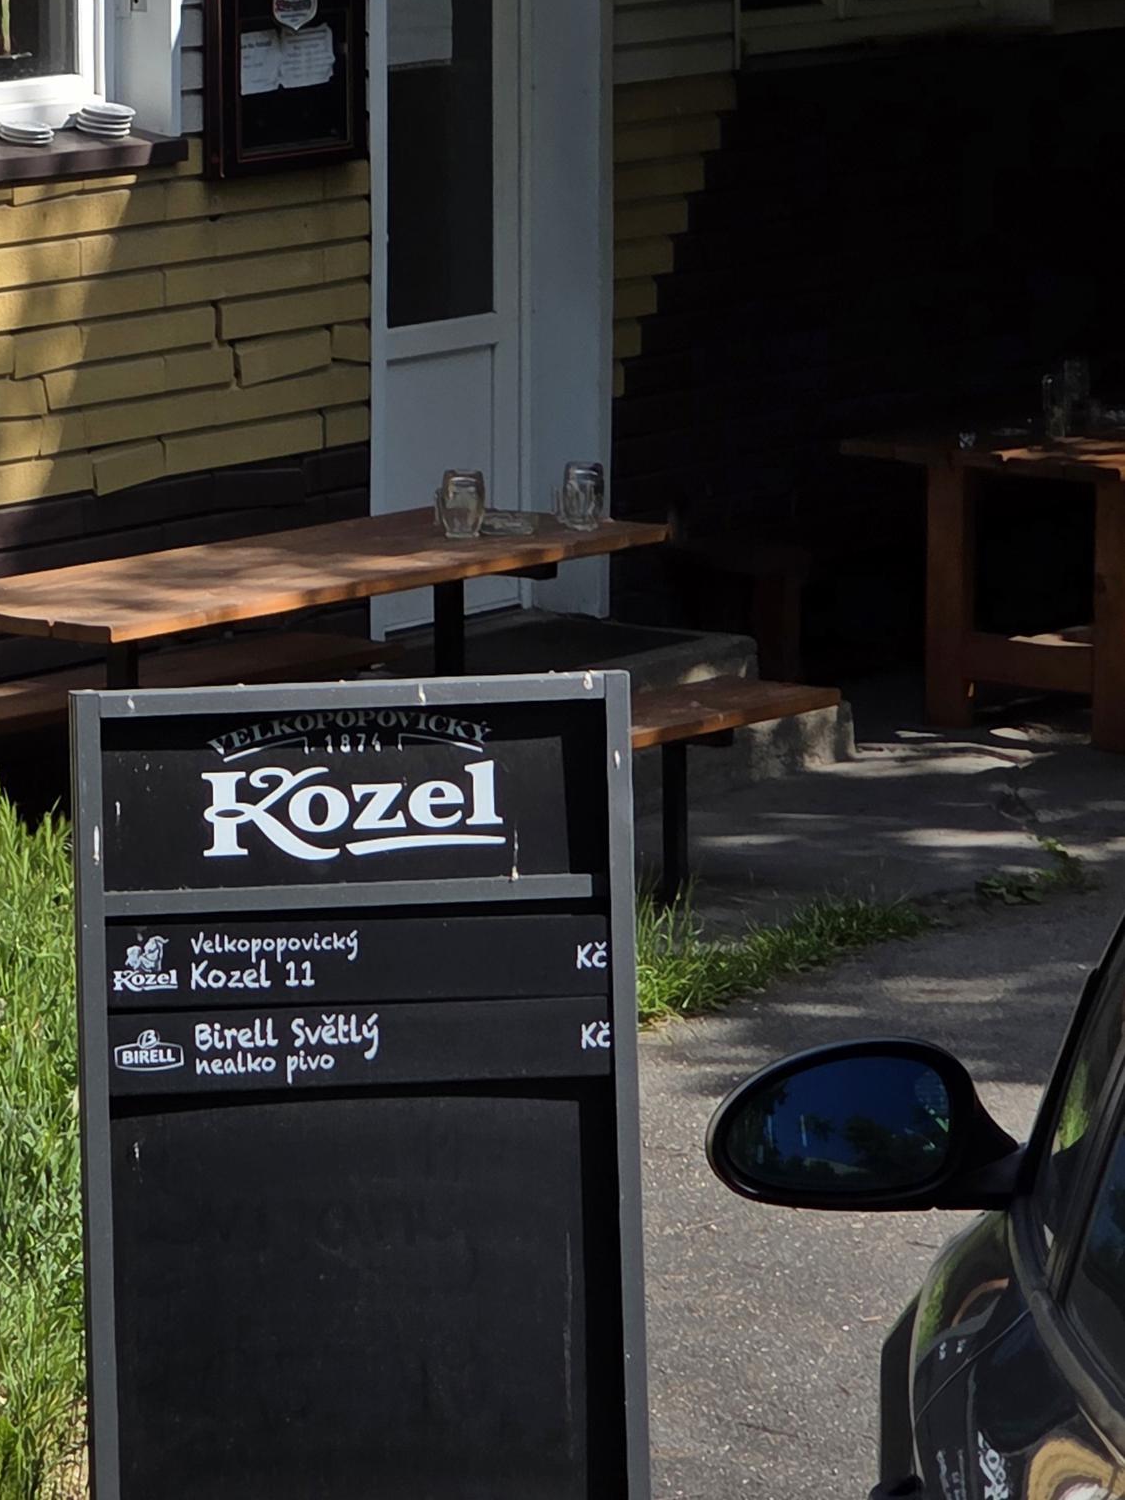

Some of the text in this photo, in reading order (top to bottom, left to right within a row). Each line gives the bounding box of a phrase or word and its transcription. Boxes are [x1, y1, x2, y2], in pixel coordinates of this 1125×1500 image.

[206, 709, 492, 756] VELKOPOPOVICKÝ
[201, 760, 504, 861] Kozel
[190, 929, 359, 963] Velkopopovický
[576, 941, 607, 970] Kč
[113, 969, 178, 991] Kozel
[190, 958, 316, 991] Kozel 11
[194, 1012, 380, 1060] Birell Světlý
[581, 1020, 611, 1049] Kč
[122, 1048, 176, 1065] BIRELL
[195, 1051, 335, 1085] nealko pivo
